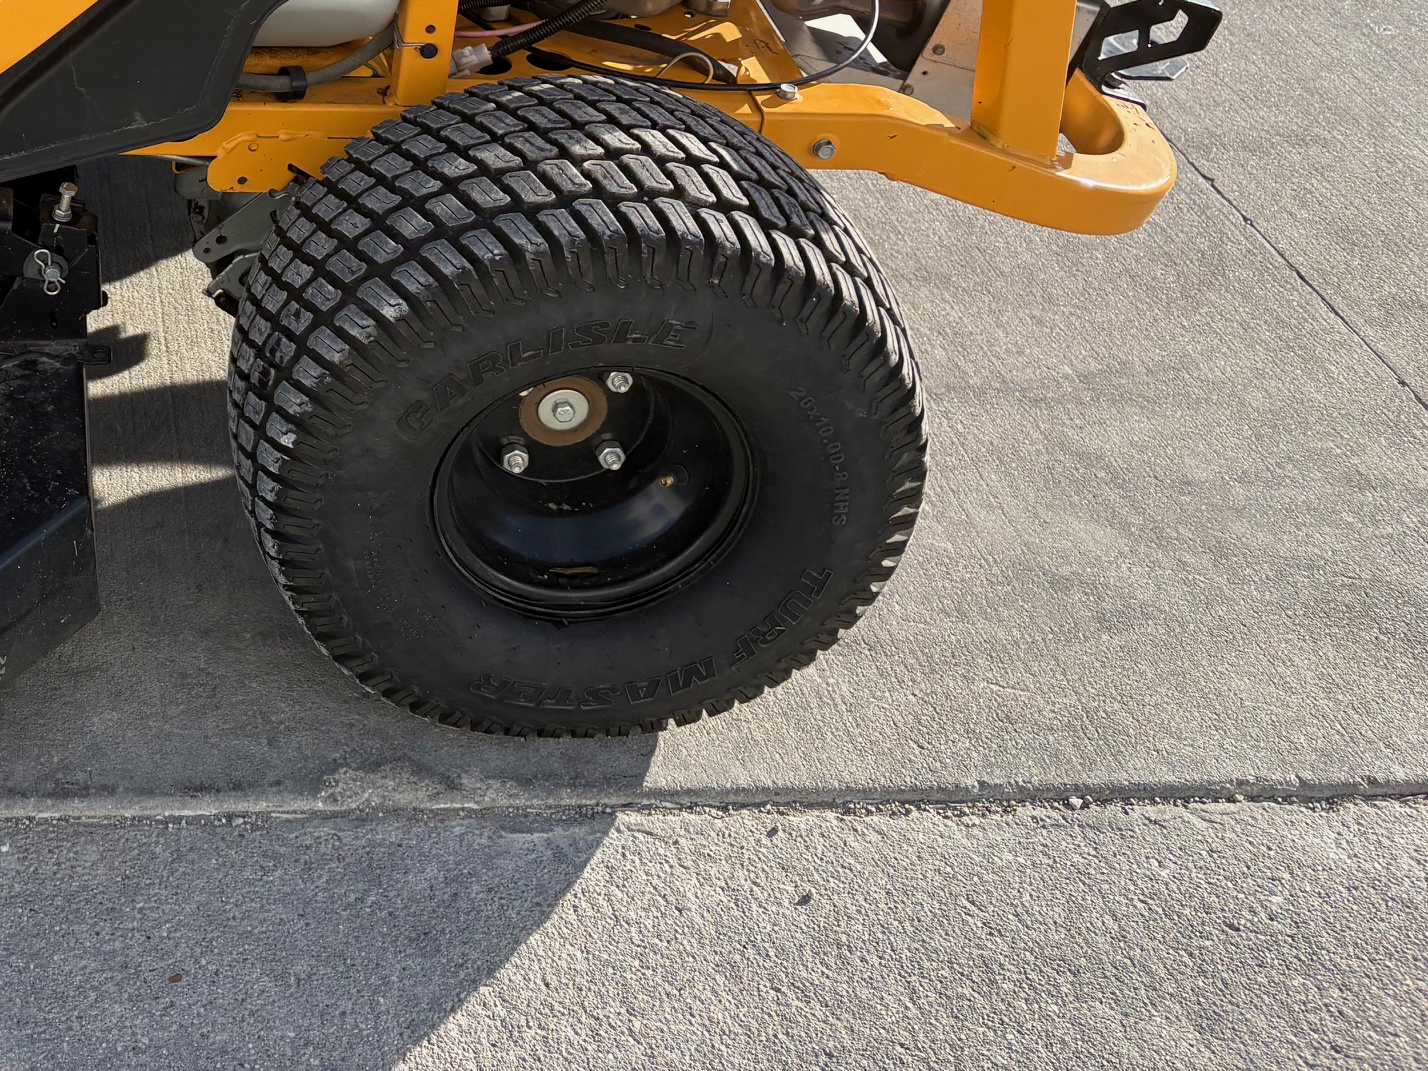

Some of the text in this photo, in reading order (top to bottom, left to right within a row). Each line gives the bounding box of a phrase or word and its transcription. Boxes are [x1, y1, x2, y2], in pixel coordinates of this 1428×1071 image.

[396, 316, 699, 440] CARLISLE
[831, 487, 850, 527] NHS
[468, 567, 834, 710] TURF MASTER
